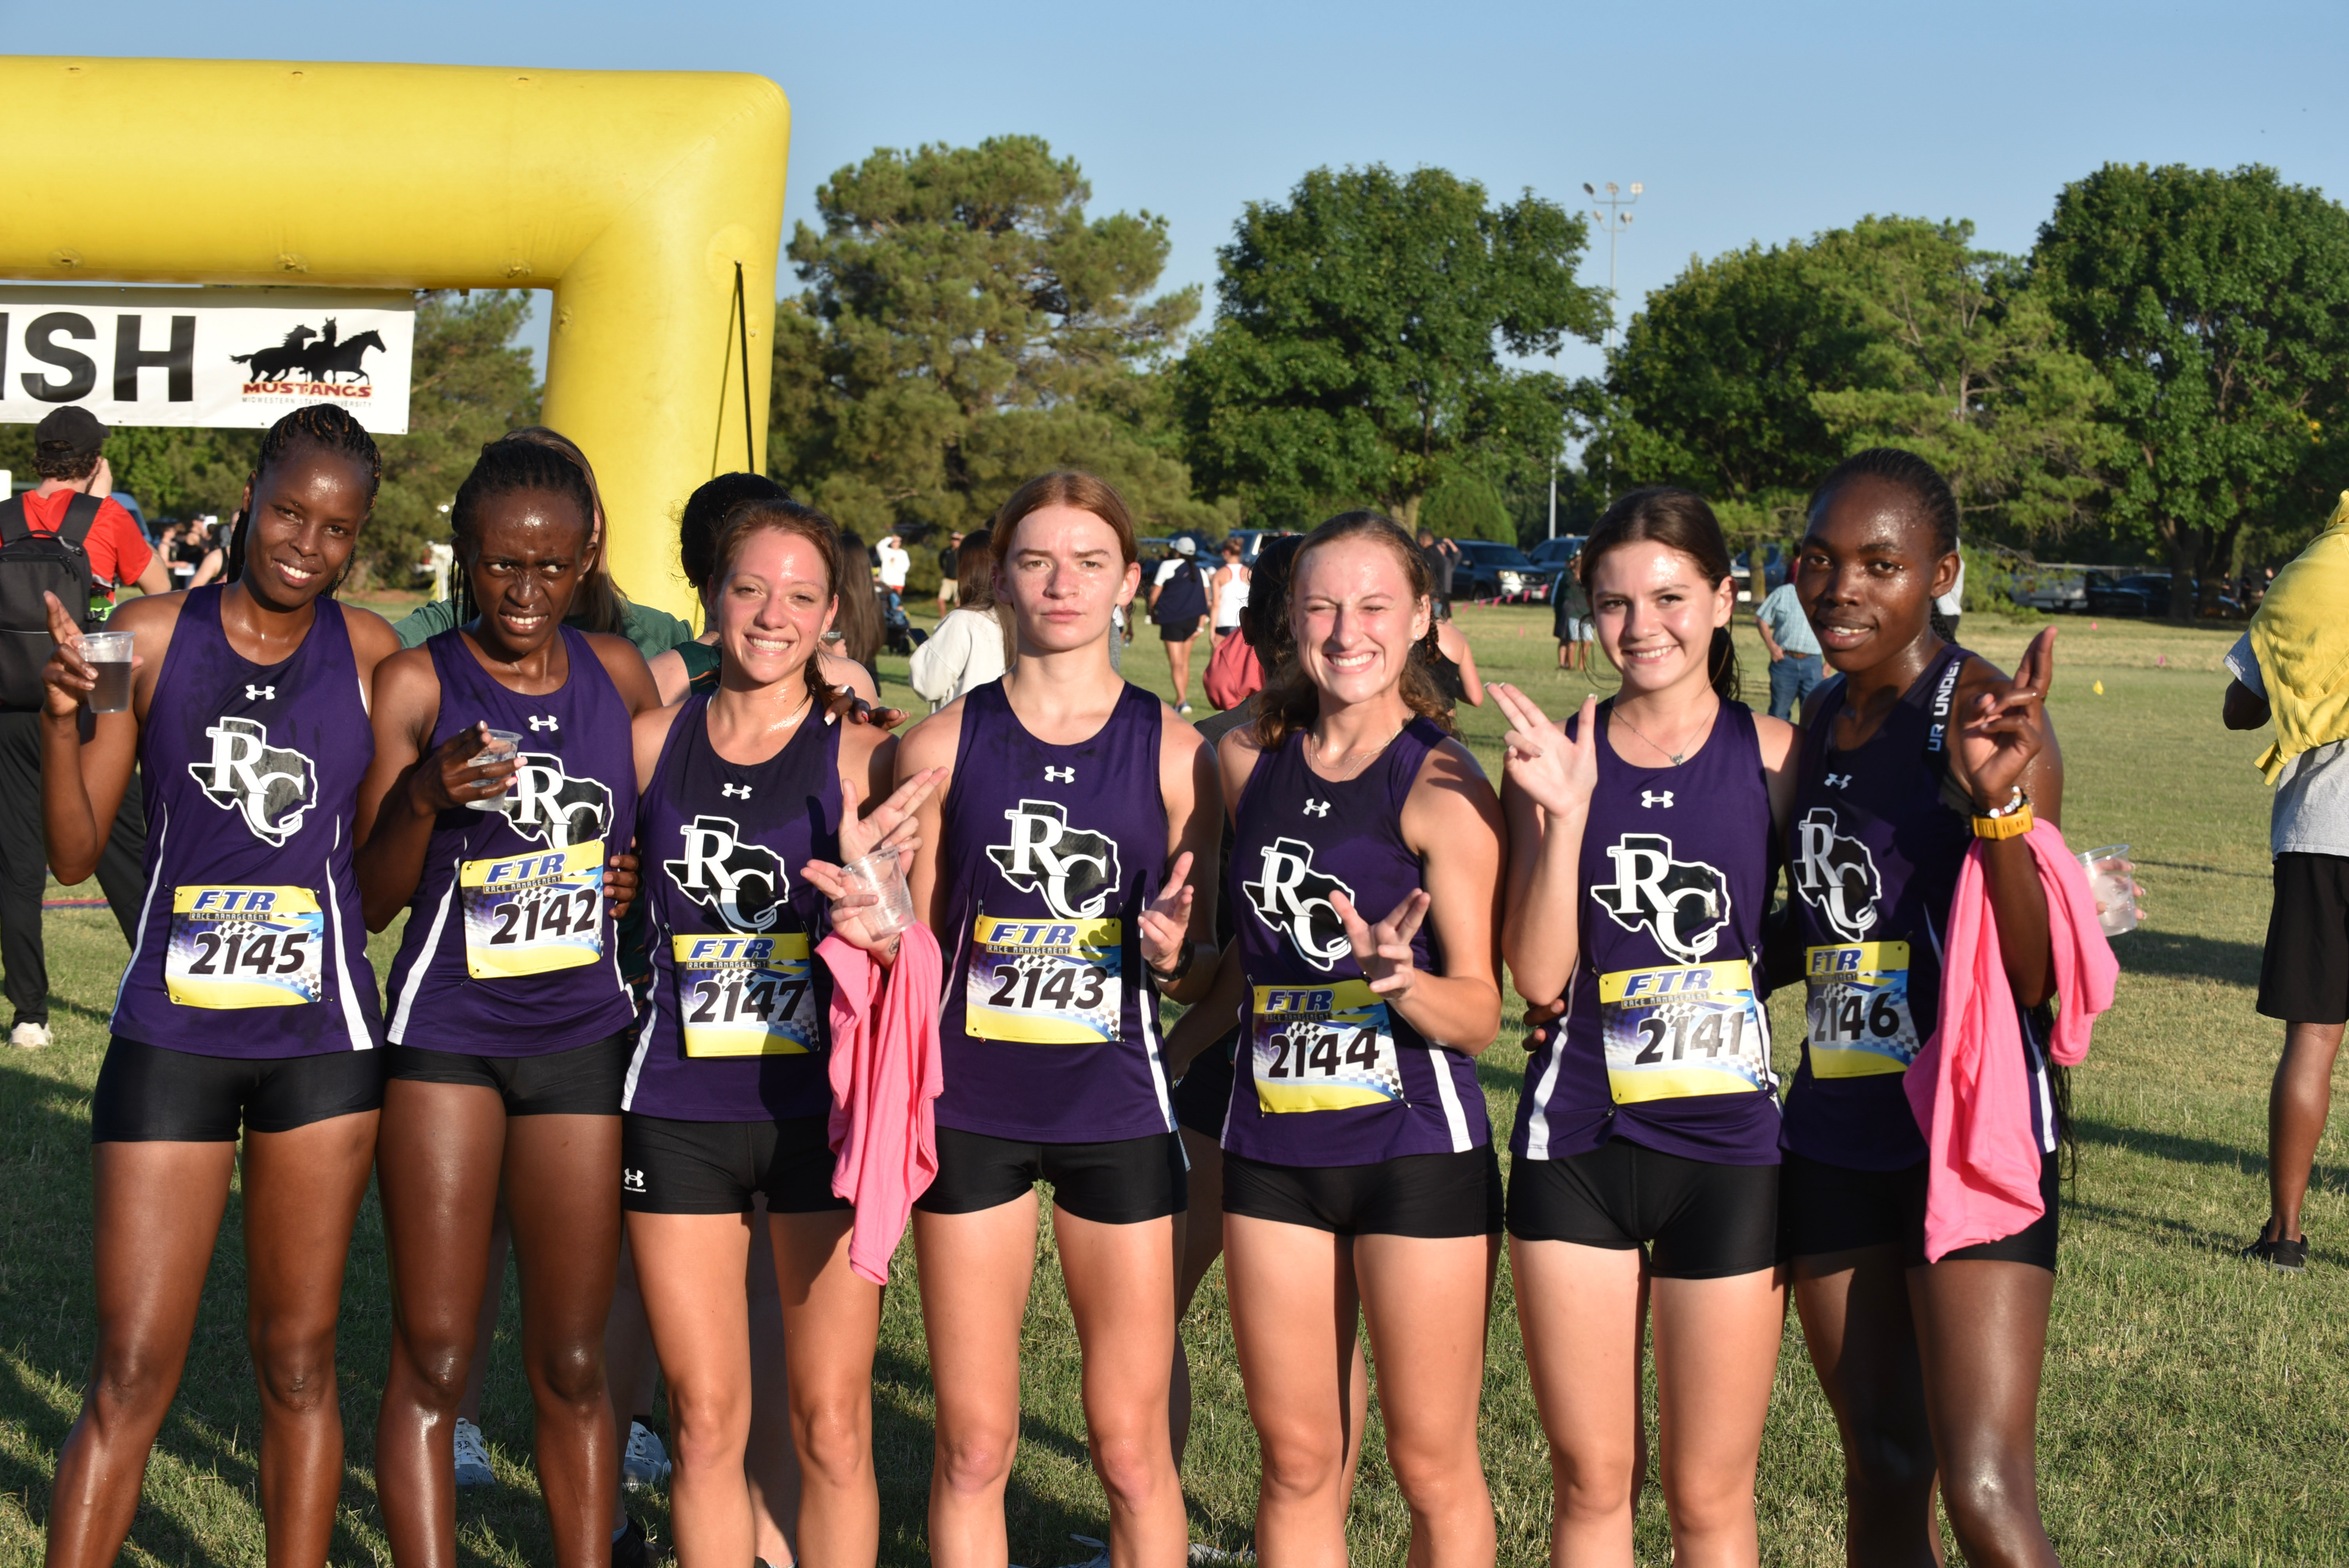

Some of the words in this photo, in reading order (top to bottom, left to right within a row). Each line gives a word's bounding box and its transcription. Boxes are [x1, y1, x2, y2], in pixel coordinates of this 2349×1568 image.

[243, 383, 372, 397] MUSTANGS
[207, 730, 303, 834] RC
[513, 765, 604, 848] RC
[484, 852, 566, 884] FTR
[511, 876, 561, 890] MANAGEMENT
[682, 828, 777, 928] RC
[1006, 813, 1107, 918] RC
[1800, 823, 1877, 929] RC
[191, 890, 278, 912] FTR
[489, 888, 597, 945] 2142
[1259, 850, 1351, 957] RC
[1610, 850, 1717, 954] RC
[188, 932, 311, 975] 2145
[688, 938, 776, 960] FTR
[988, 922, 1078, 946] FTR
[1013, 946, 1069, 954] MANAGEMENT
[1811, 948, 1863, 973] FTR
[689, 980, 809, 1023] 2147
[988, 965, 1107, 1010] 2143
[1265, 989, 1335, 1012] FTR
[1621, 968, 1713, 999] FTR
[1623, 999, 1645, 1007] RACE
[1634, 1011, 1746, 1065] 2141
[1814, 992, 1900, 1042] 2146
[1268, 1027, 1380, 1078] 2144
